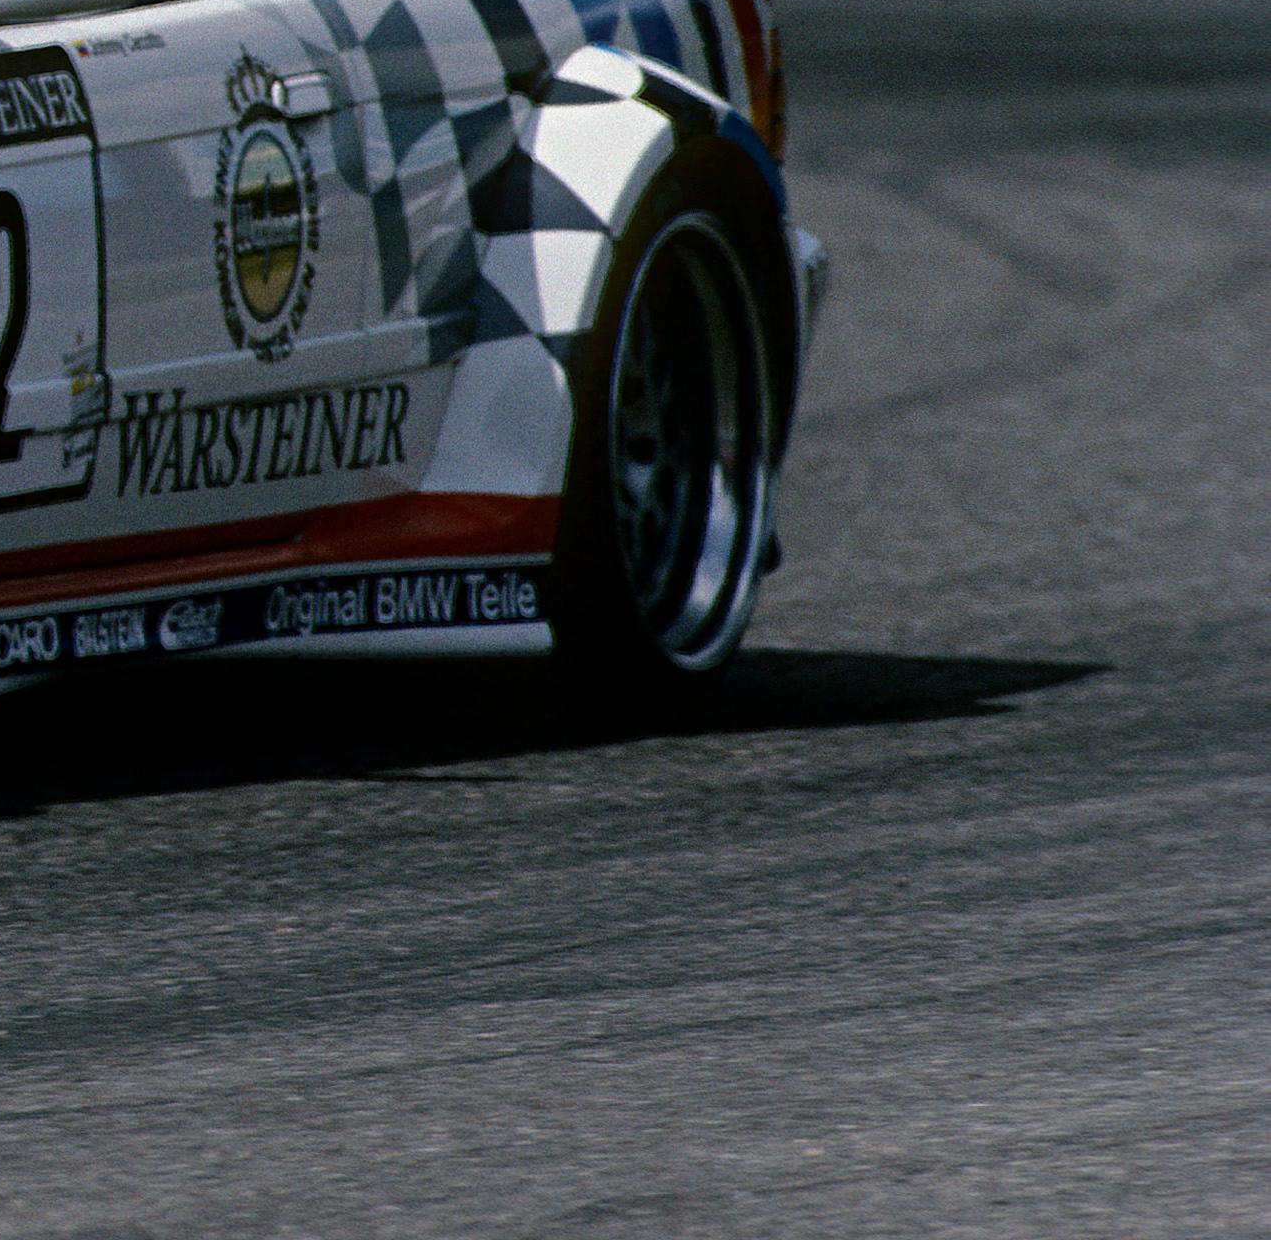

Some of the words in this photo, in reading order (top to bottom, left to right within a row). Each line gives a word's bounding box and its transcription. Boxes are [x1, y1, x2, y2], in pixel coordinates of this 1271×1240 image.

[115, 380, 408, 498] WARSTEINER
[263, 575, 369, 636] Original
[374, 571, 460, 625] BMW
[462, 568, 541, 621] Teile
